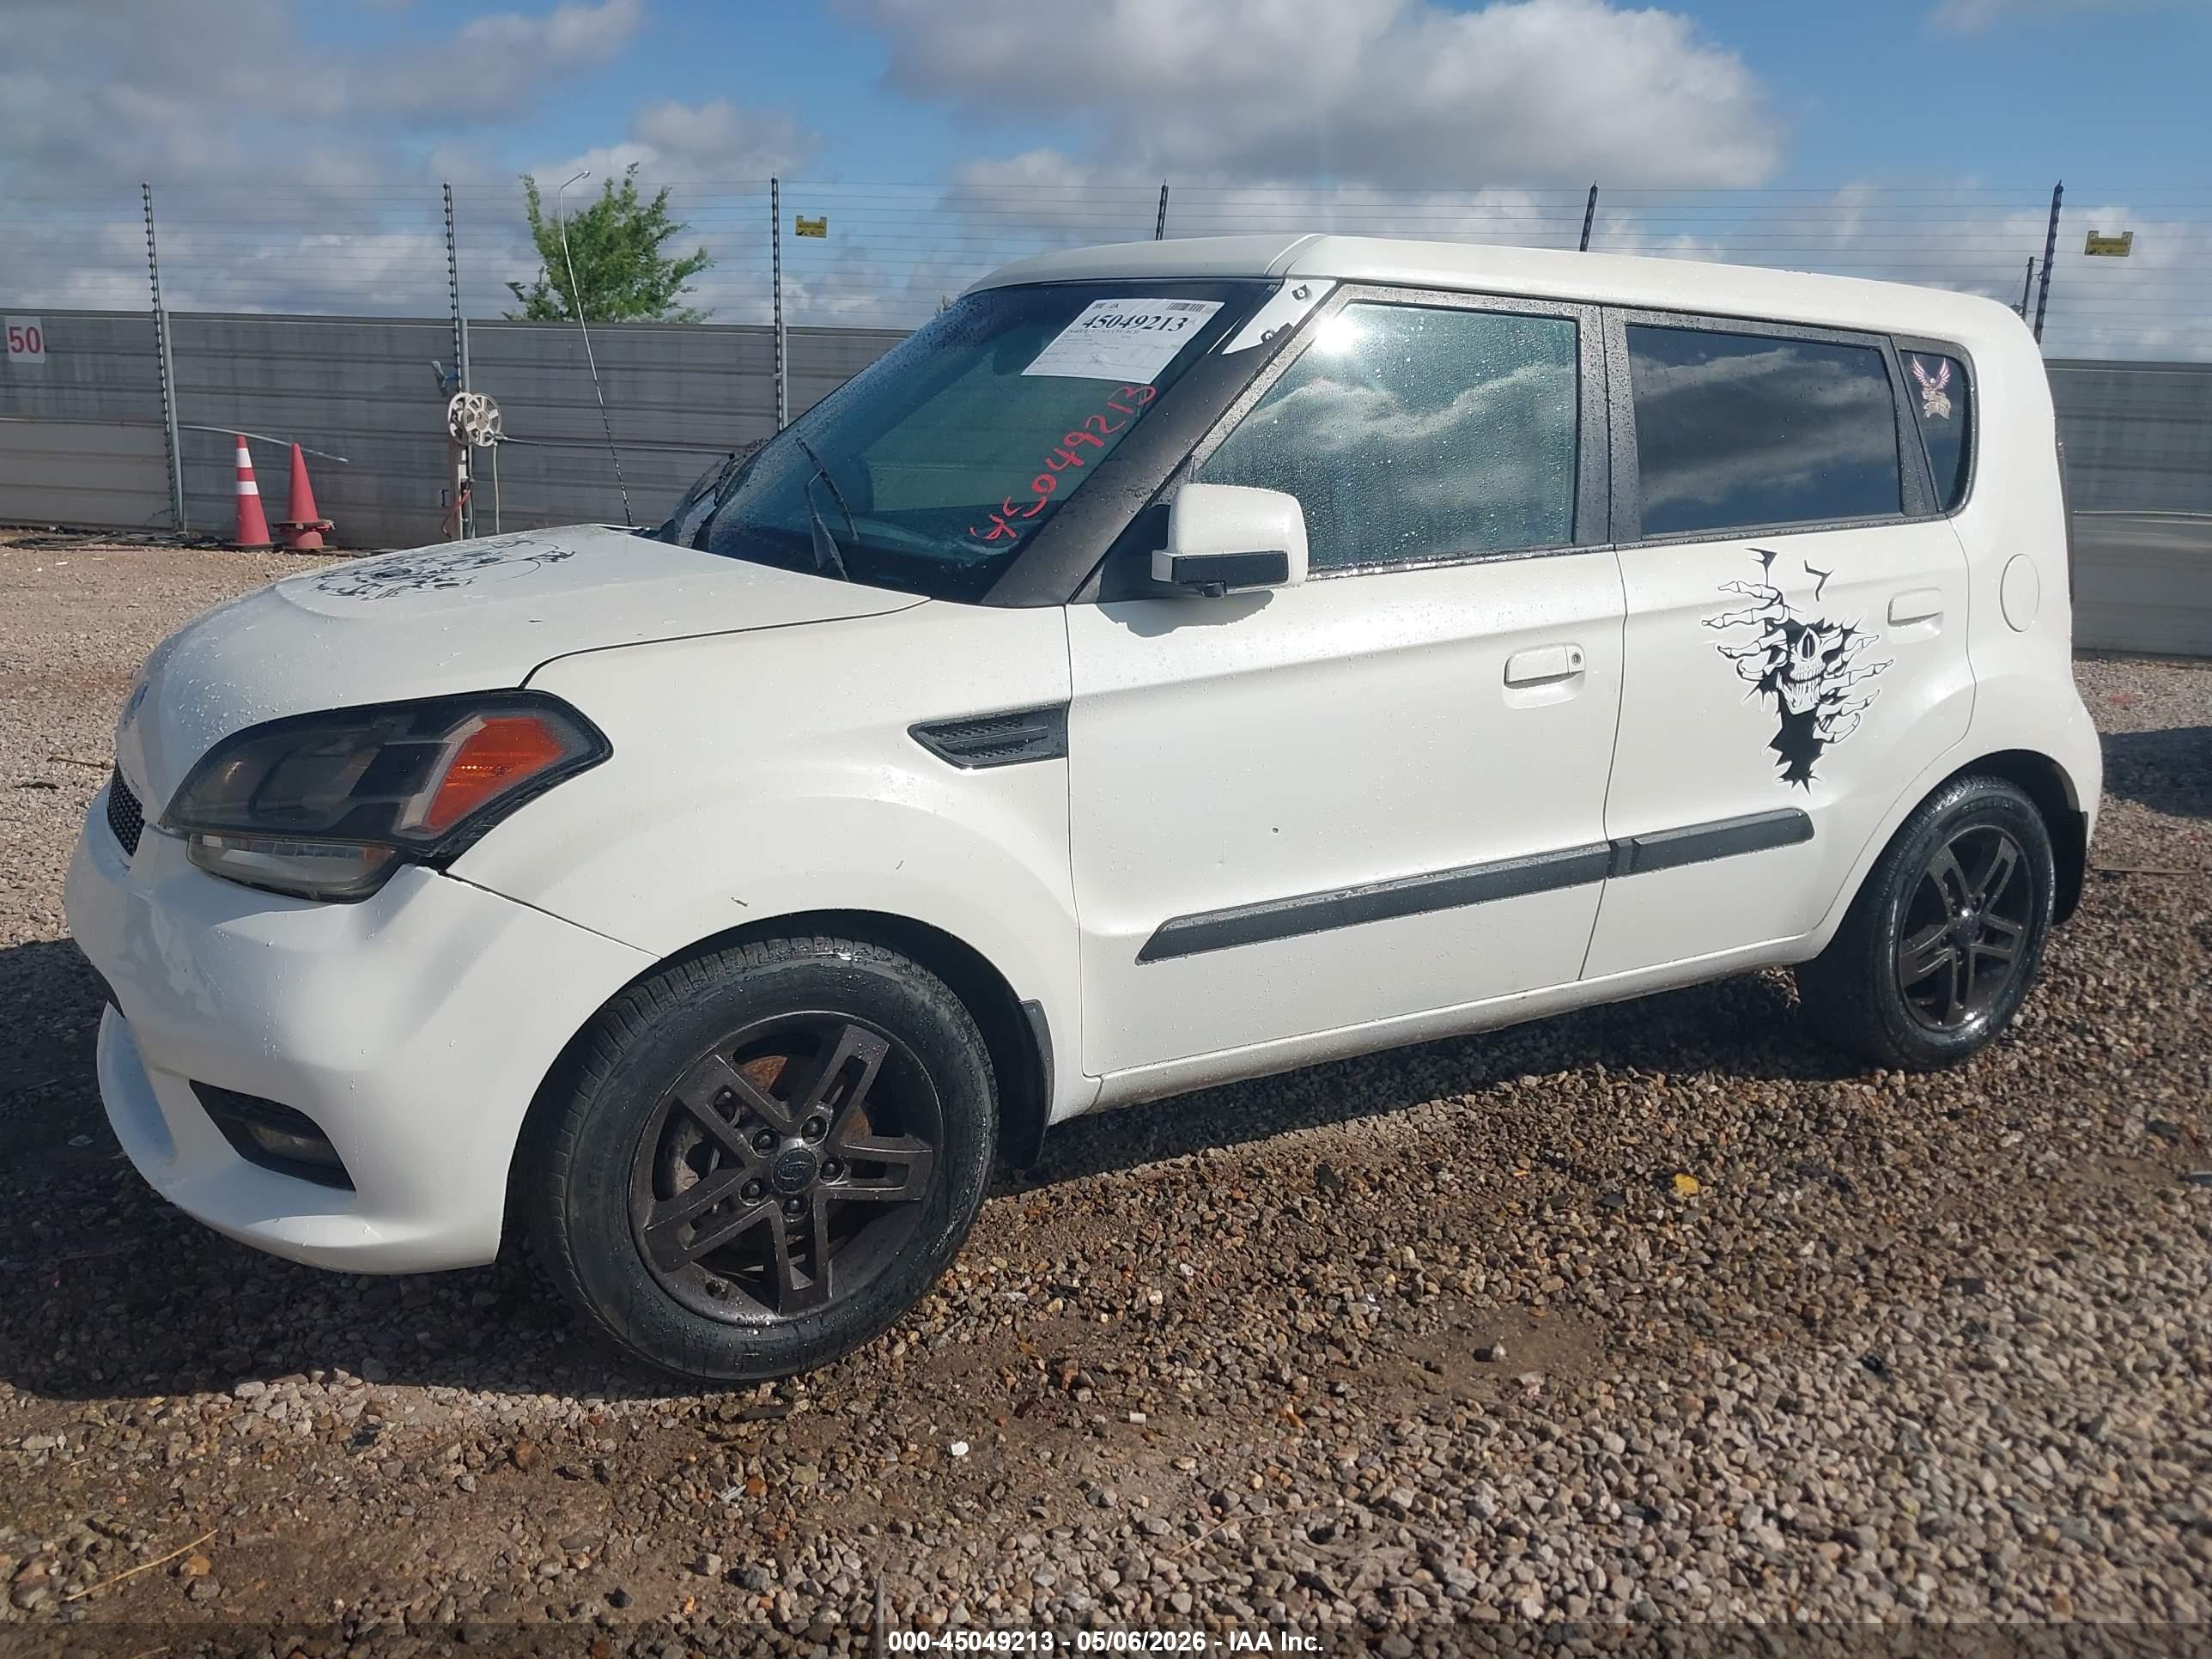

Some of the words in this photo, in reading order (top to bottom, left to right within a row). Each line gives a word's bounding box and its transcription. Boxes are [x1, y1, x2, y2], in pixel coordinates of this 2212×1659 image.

[1082, 314, 1188, 332] 45049213
[9, 326, 41, 354] 50
[969, 386, 1156, 540] 45049213
